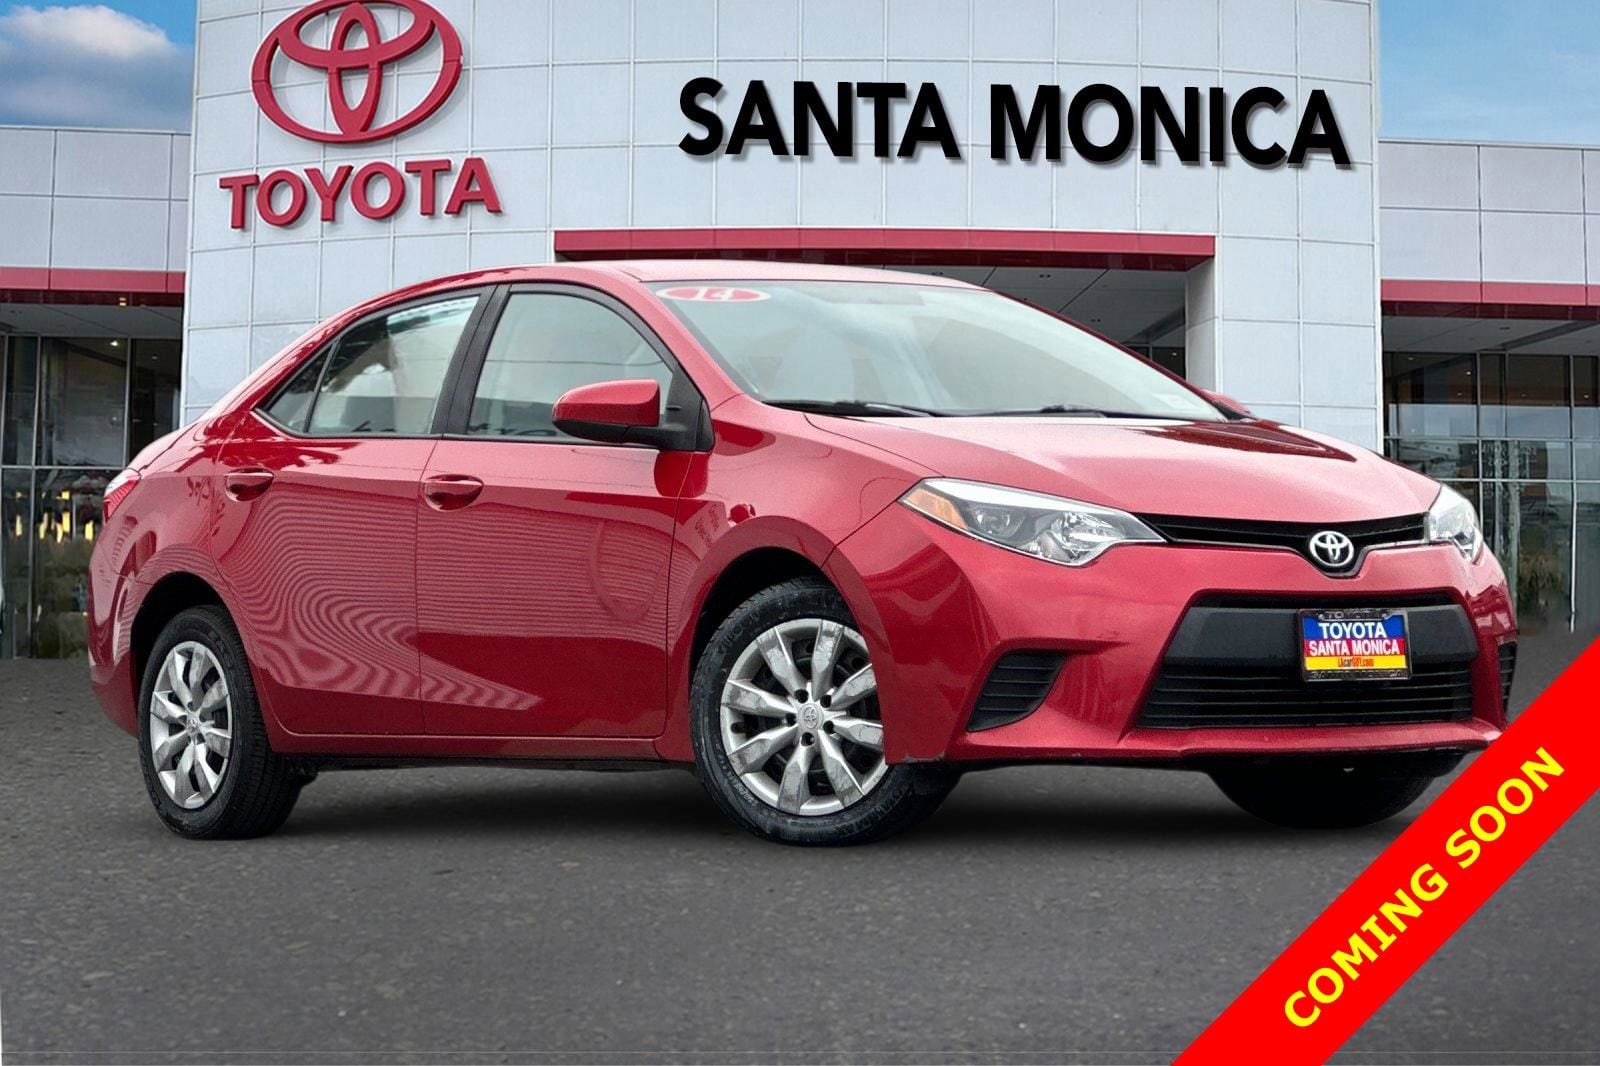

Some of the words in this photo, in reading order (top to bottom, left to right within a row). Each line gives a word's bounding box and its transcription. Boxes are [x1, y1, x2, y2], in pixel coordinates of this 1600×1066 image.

[678, 77, 961, 158] SANTA
[990, 83, 1351, 168] MONICA
[220, 157, 501, 229] TOYOTA
[1309, 640, 1350, 656] SANTA
[1352, 639, 1400, 655] MONICA
[1318, 622, 1387, 639] TOYOTA
